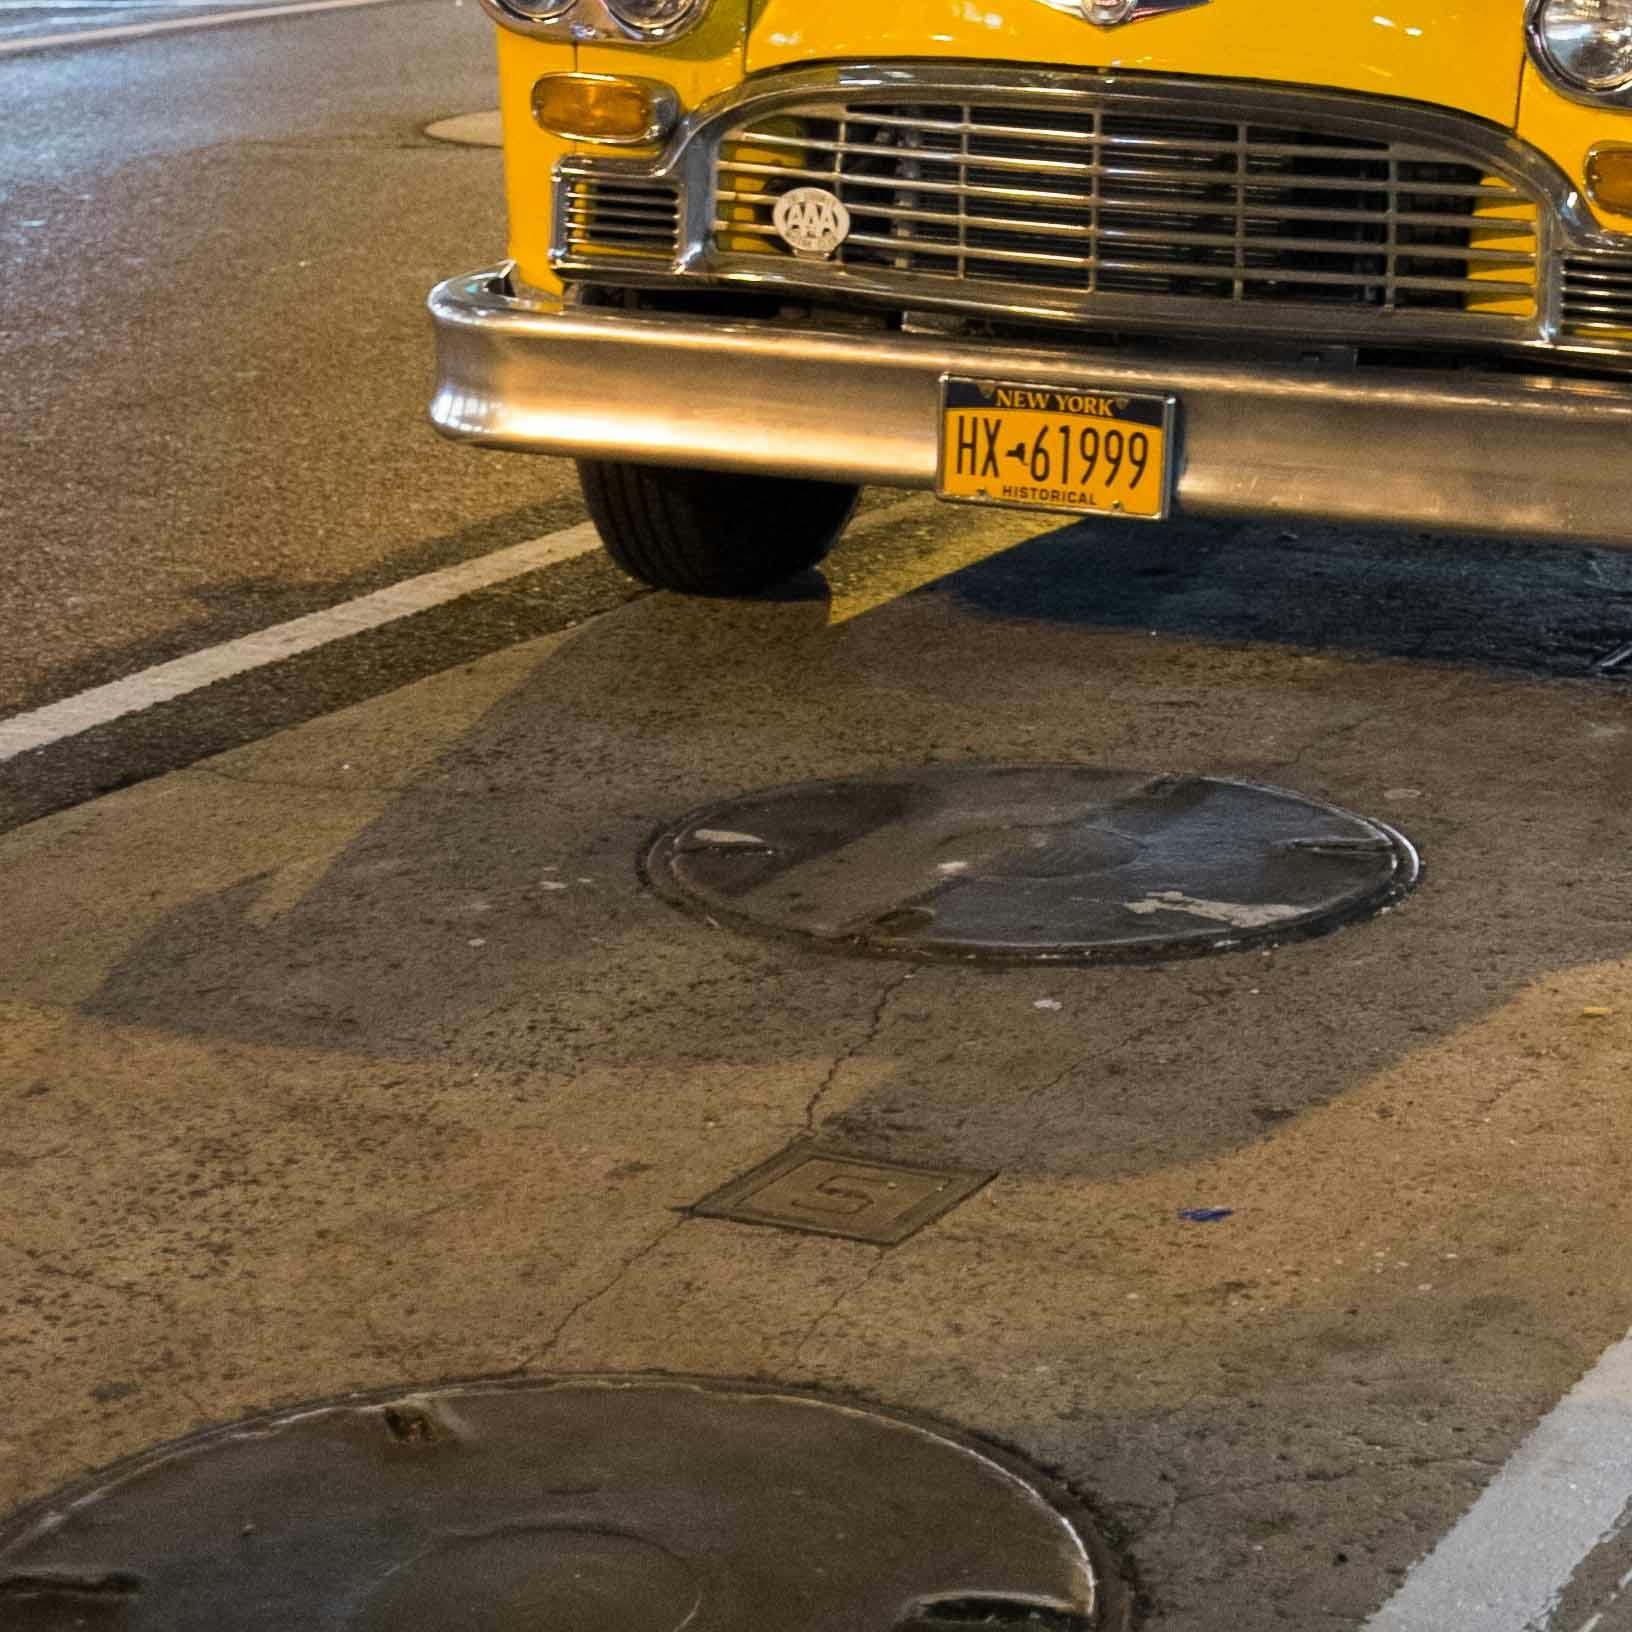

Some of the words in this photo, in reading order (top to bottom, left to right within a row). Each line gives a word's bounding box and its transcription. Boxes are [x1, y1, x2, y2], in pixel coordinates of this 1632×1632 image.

[785, 201, 837, 234] AAA
[995, 389, 1050, 410] NEW
[1055, 395, 1115, 417] YORK
[1002, 485, 1097, 506] HISTORICAL
